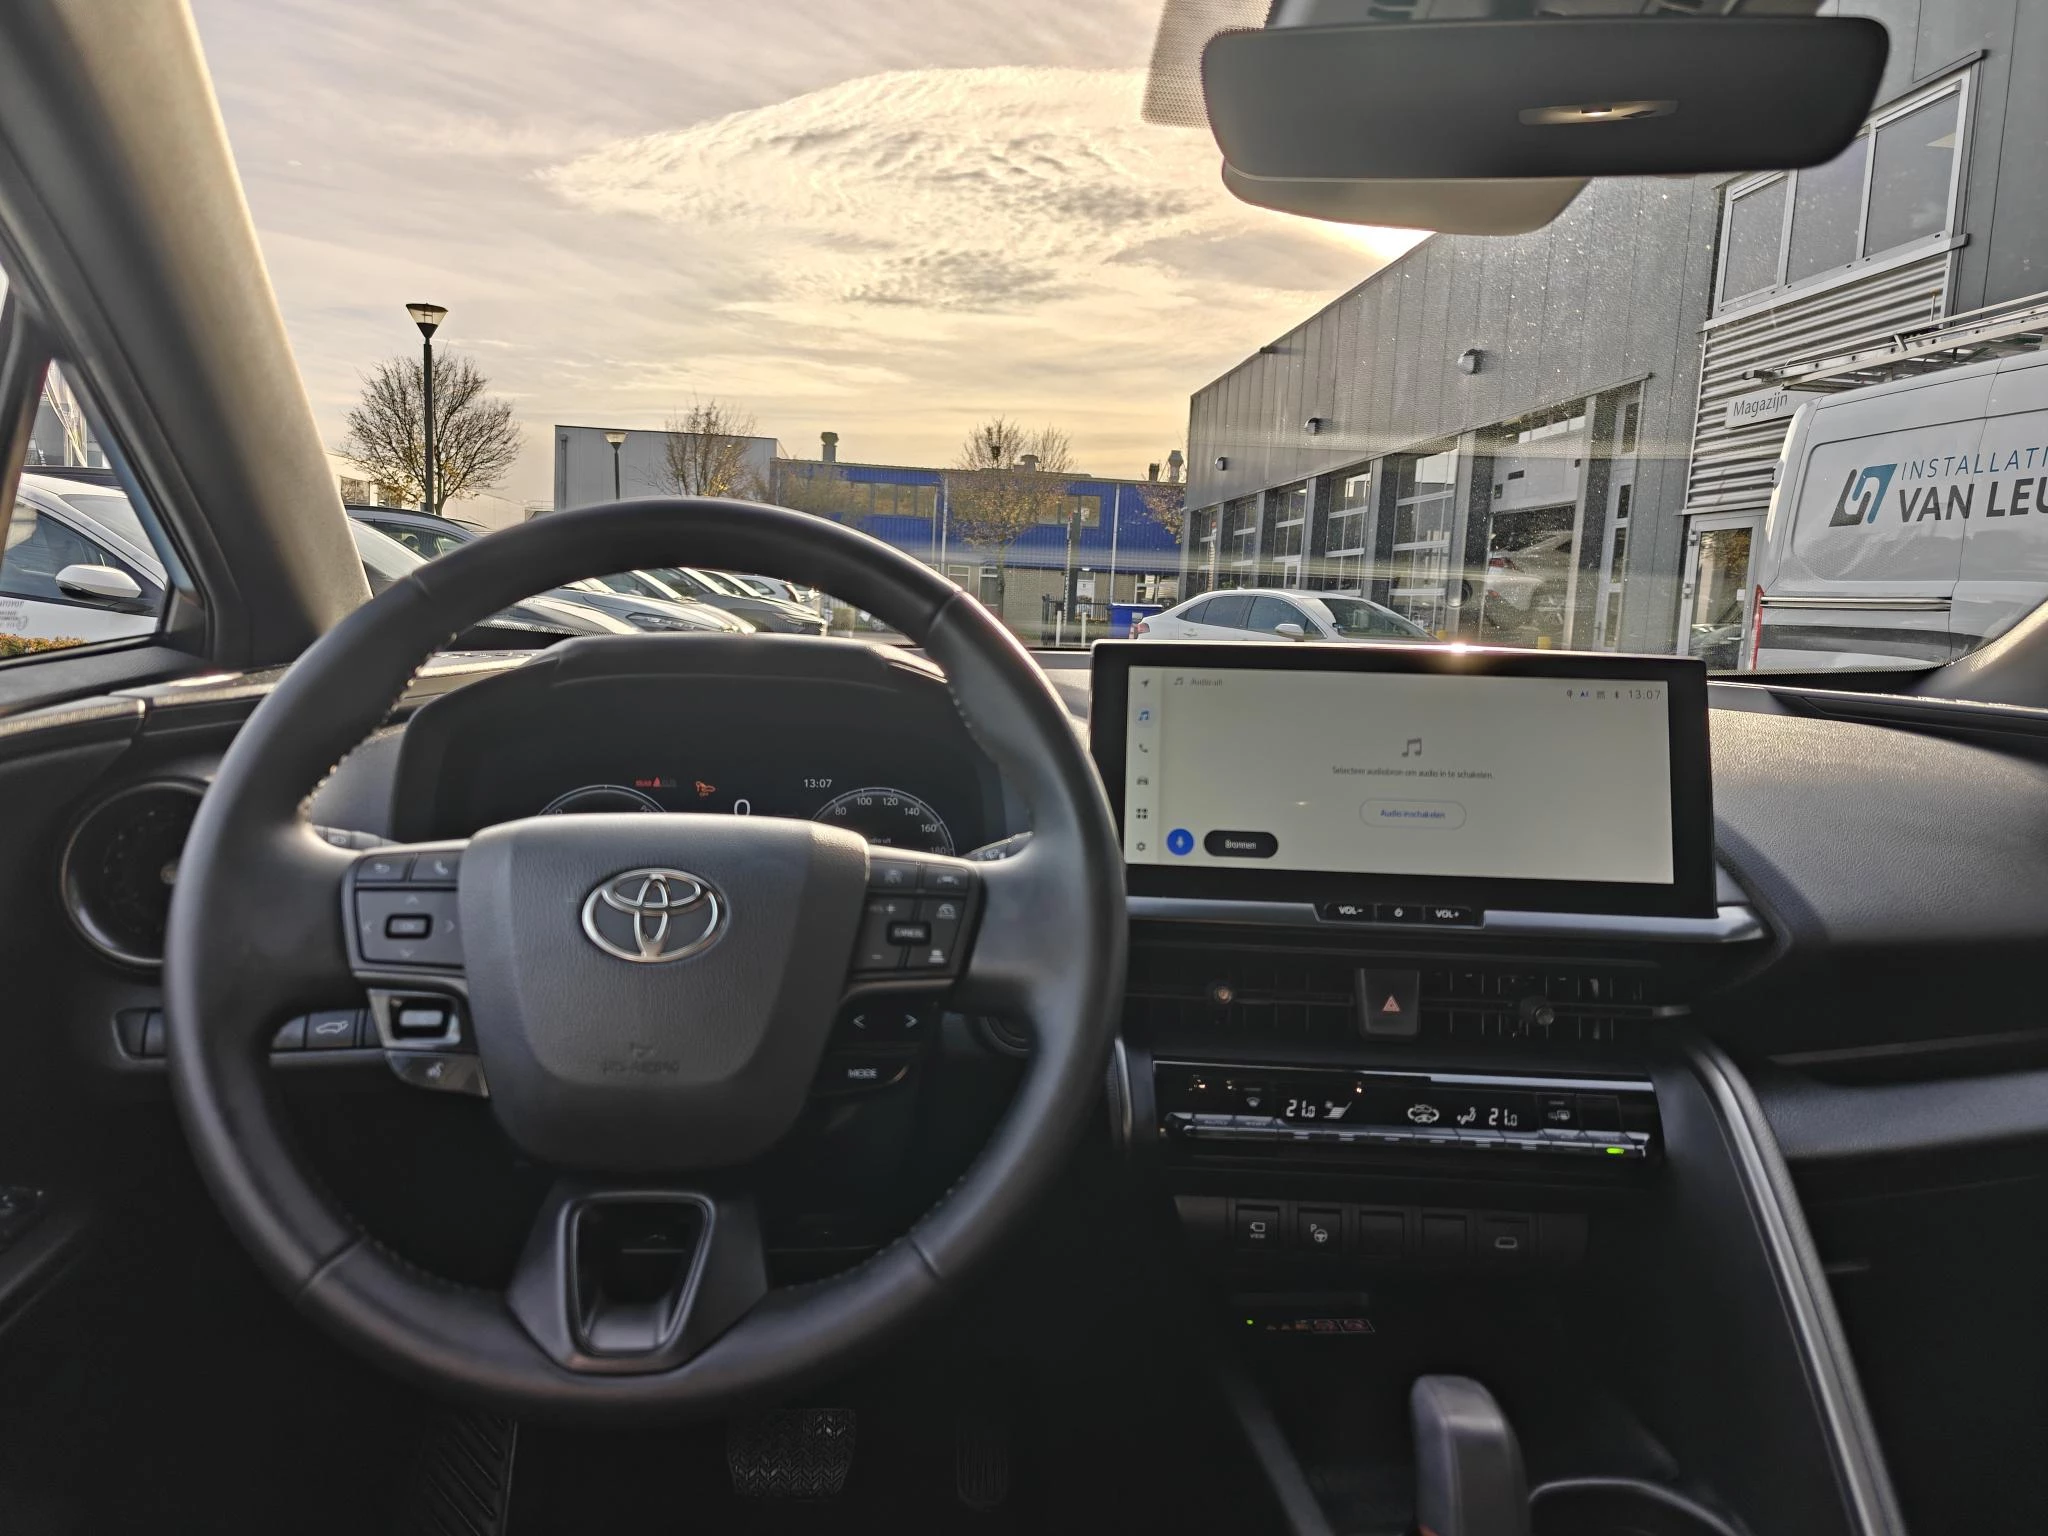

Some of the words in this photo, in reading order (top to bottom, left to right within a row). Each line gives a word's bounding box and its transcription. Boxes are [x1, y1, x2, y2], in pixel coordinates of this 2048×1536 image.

[1733, 391, 1788, 416] Magazijn
[1899, 483, 1975, 522] VAN
[1629, 689, 1661, 700] 13:07
[804, 778, 832, 788] 13:07
[857, 797, 872, 806] 100
[882, 797, 899, 806] 120
[835, 807, 847, 816] 80
[904, 807, 920, 817] 140
[1380, 808, 1400, 817] Audio
[921, 823, 937, 833] 160
[1225, 838, 1257, 850] Bronnen
[847, 1068, 877, 1079] MODE
[1285, 1099, 1316, 1118] 21.0
[1488, 1108, 1518, 1126] 21.0
